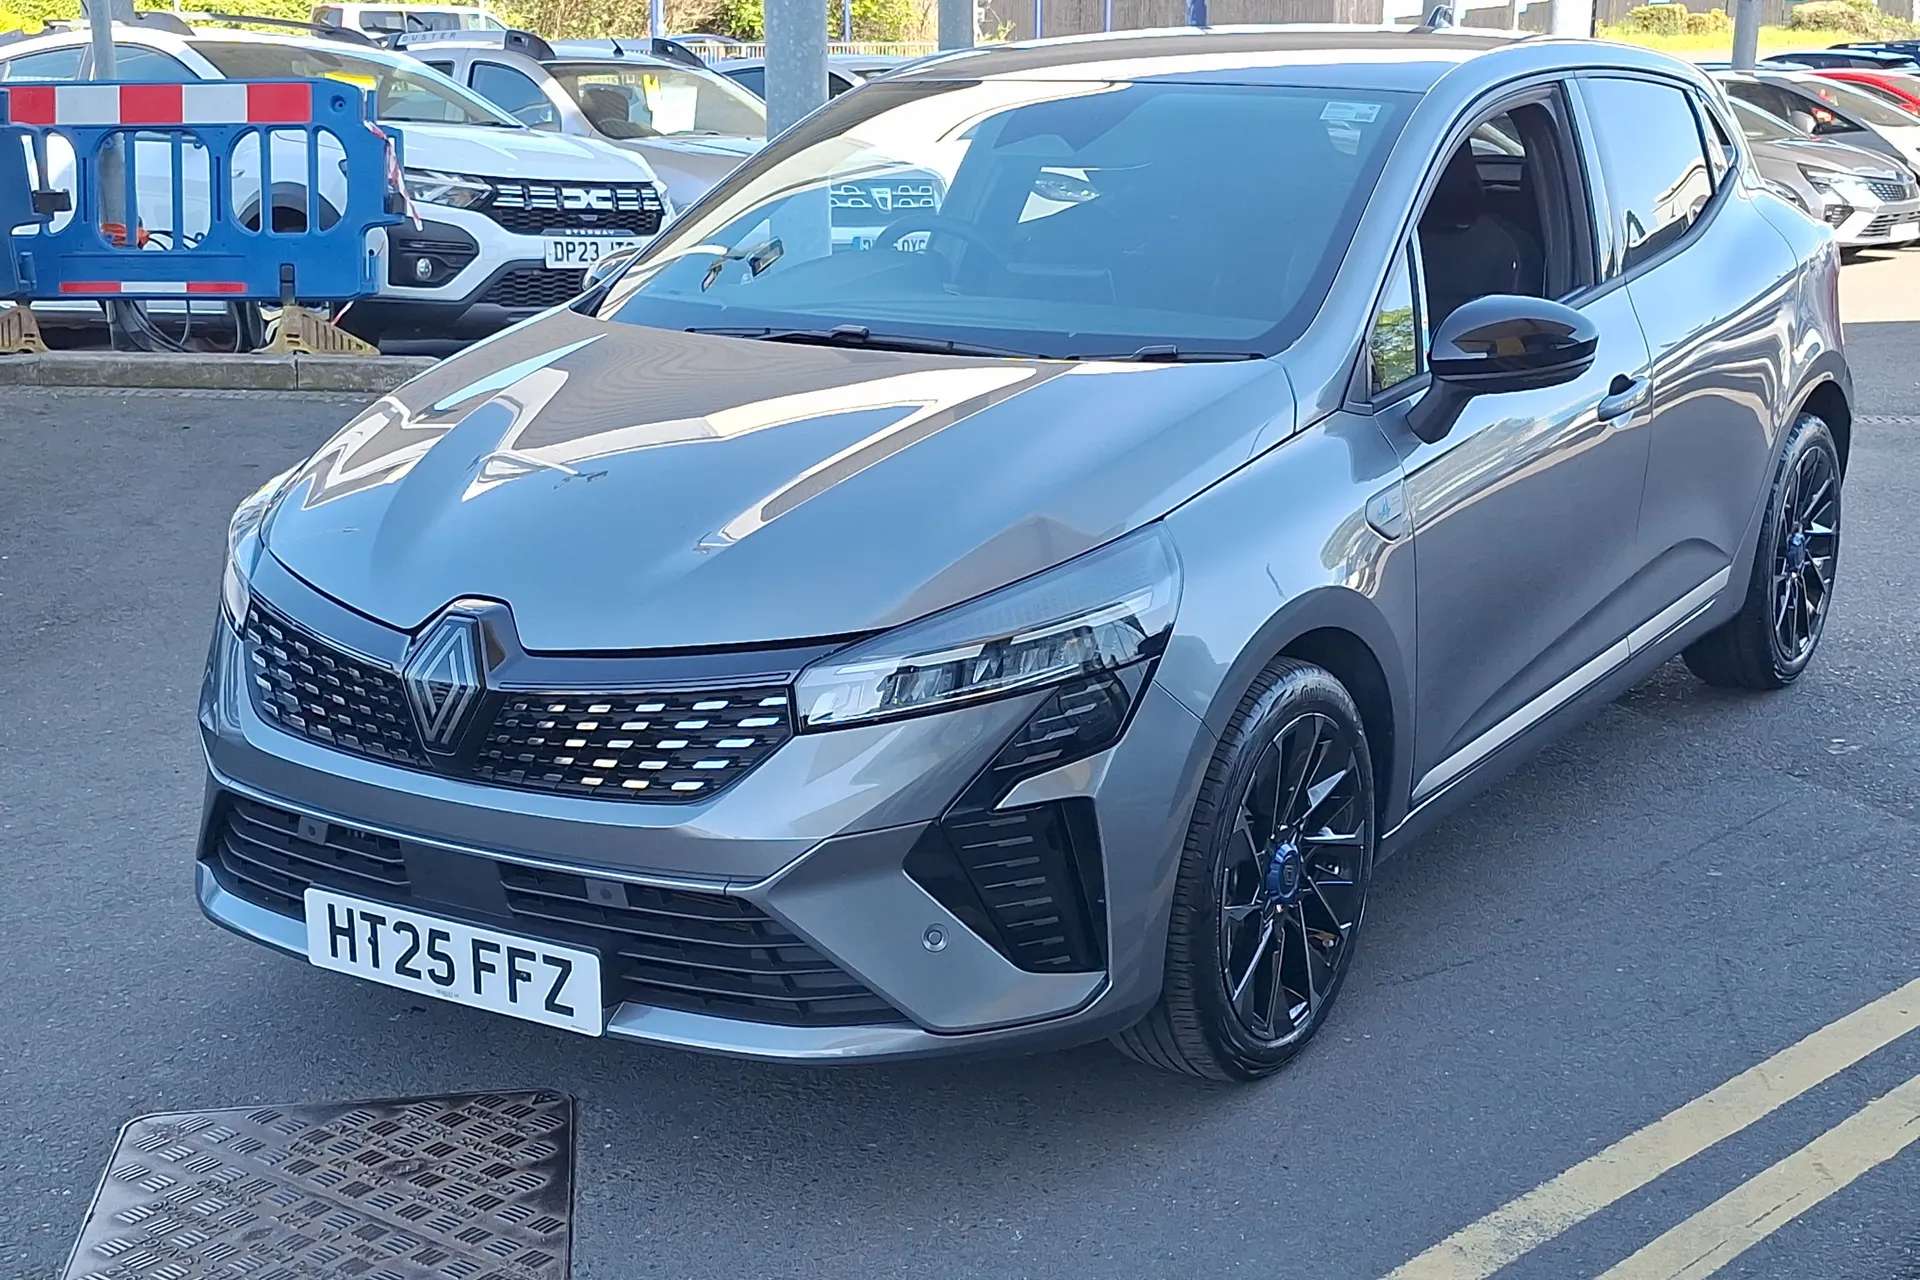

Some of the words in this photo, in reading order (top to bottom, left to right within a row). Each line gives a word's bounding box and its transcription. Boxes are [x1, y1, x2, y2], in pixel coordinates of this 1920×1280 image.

[402, 31, 457, 42] DUSTER
[553, 241, 599, 262] DP23
[327, 903, 456, 987] HT25
[471, 938, 574, 1018] FFZ
